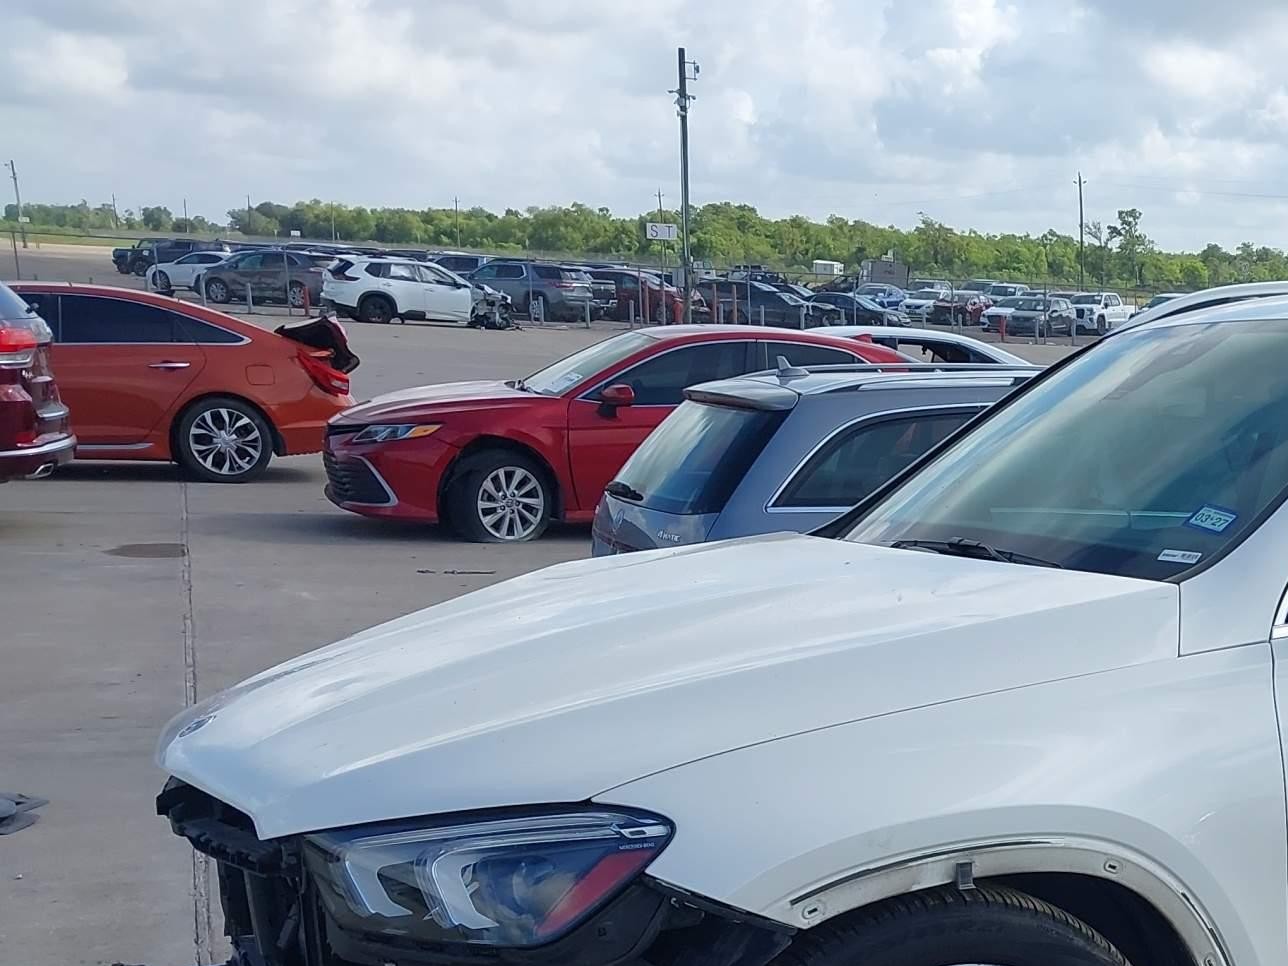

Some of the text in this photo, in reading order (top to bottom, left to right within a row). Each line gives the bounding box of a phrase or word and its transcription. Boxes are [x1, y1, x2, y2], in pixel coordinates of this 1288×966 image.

[650, 224, 673, 239] S T
[1194, 512, 1211, 523] 03
[1211, 517, 1230, 527] 27
